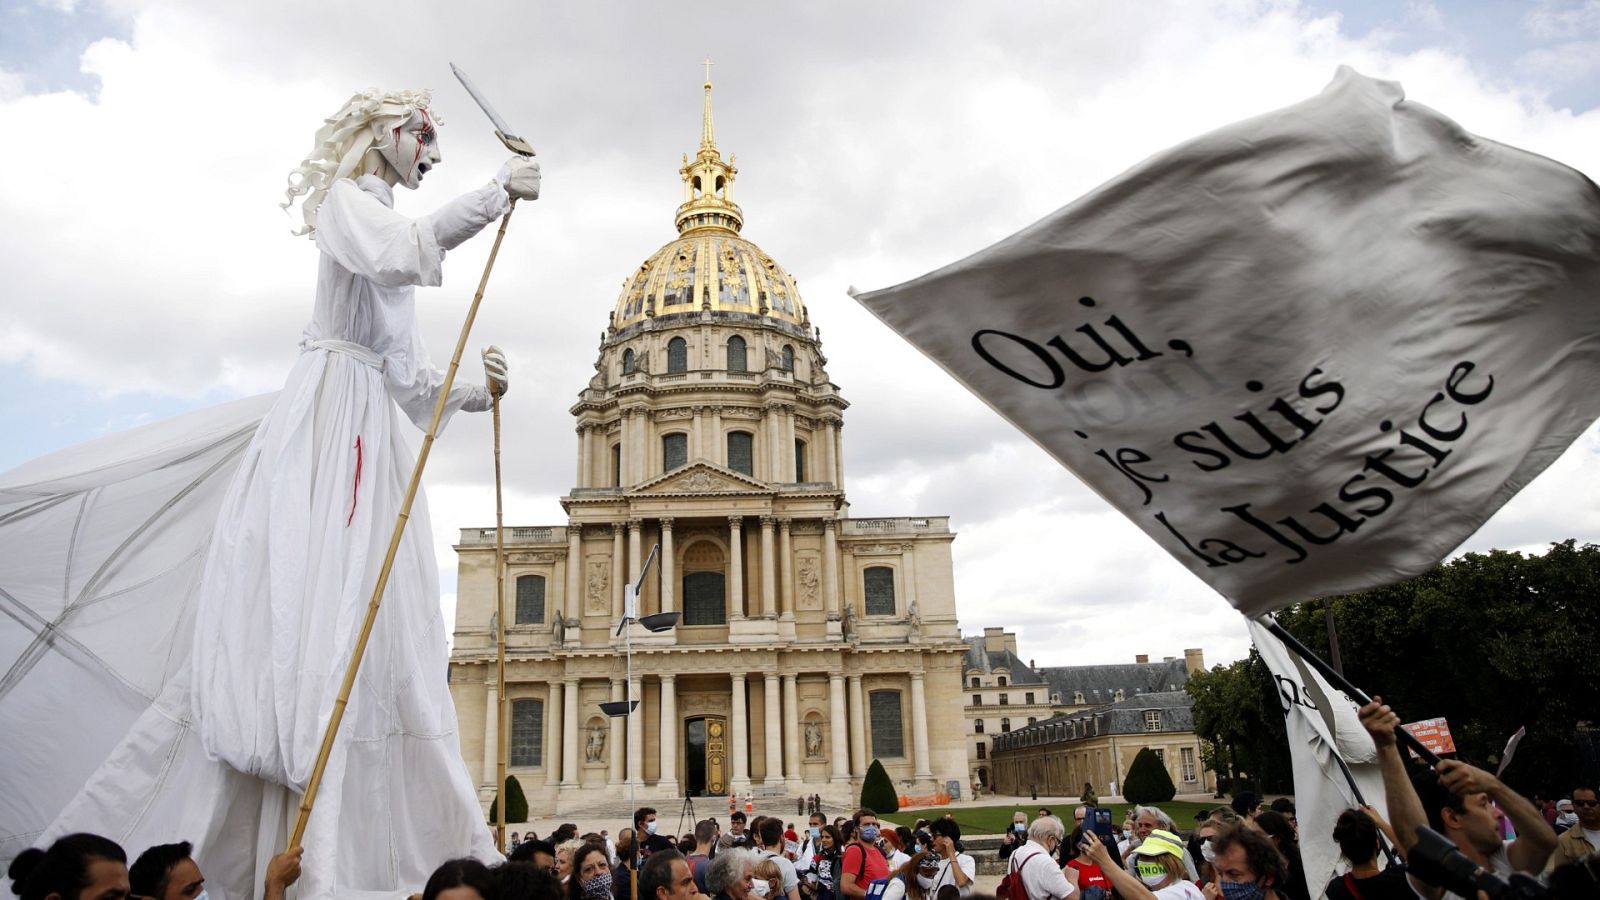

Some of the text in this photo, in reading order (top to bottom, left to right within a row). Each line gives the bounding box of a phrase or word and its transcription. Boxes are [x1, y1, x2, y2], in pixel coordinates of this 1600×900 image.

[971, 295, 1194, 390] Oui,
[1074, 430, 1170, 506] je
[1173, 366, 1346, 473] suis
[1154, 359, 1495, 569] la Justice
